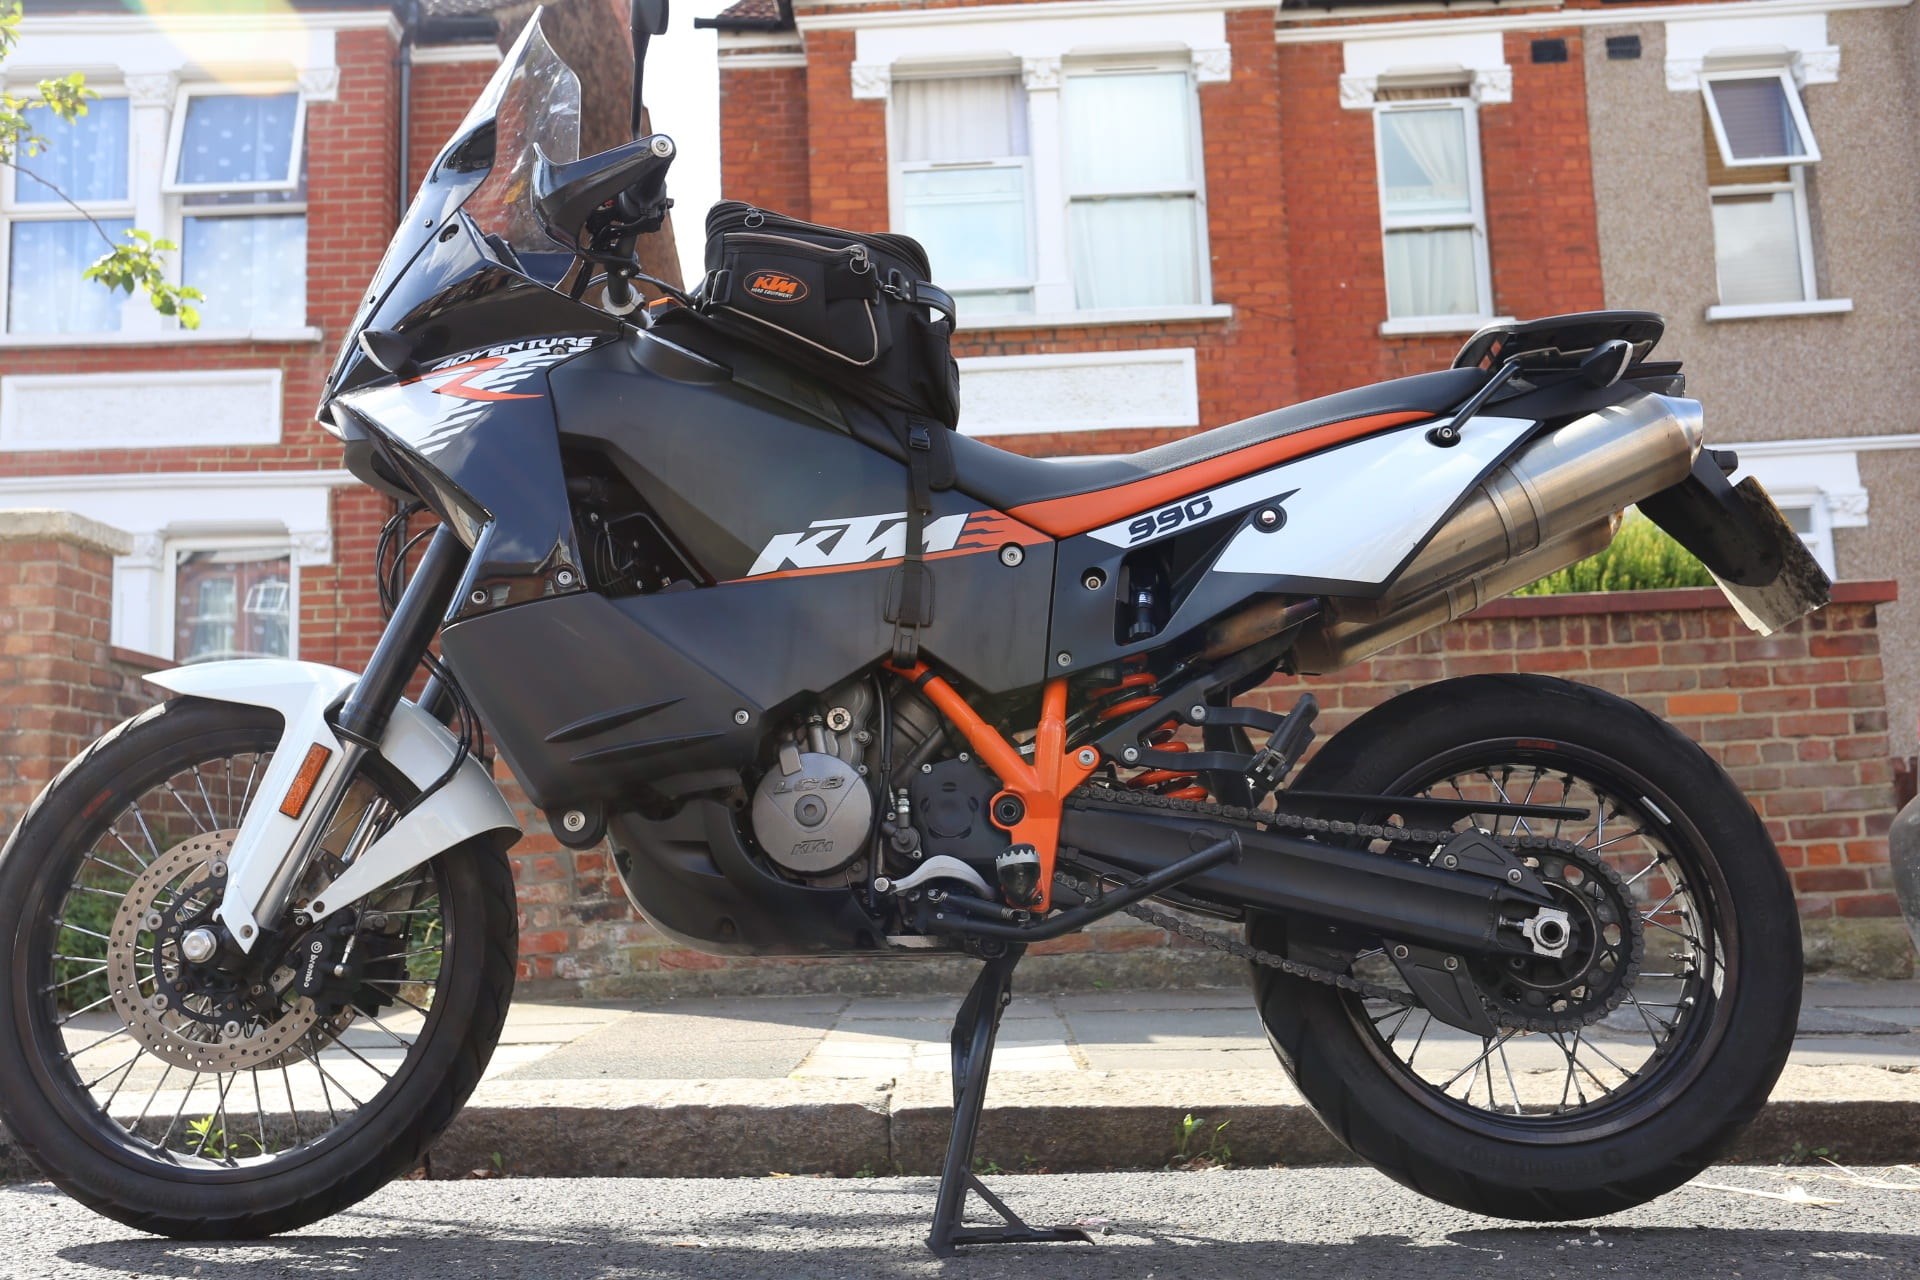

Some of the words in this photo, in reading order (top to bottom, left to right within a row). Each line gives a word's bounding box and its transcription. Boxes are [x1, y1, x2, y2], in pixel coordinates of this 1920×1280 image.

[752, 274, 798, 294] KTM
[431, 336, 598, 372] ADVENTURE
[1128, 495, 1213, 543] 990
[746, 512, 969, 577] KTM
[790, 839, 834, 856] KTM
[303, 954, 319, 988] brembo
